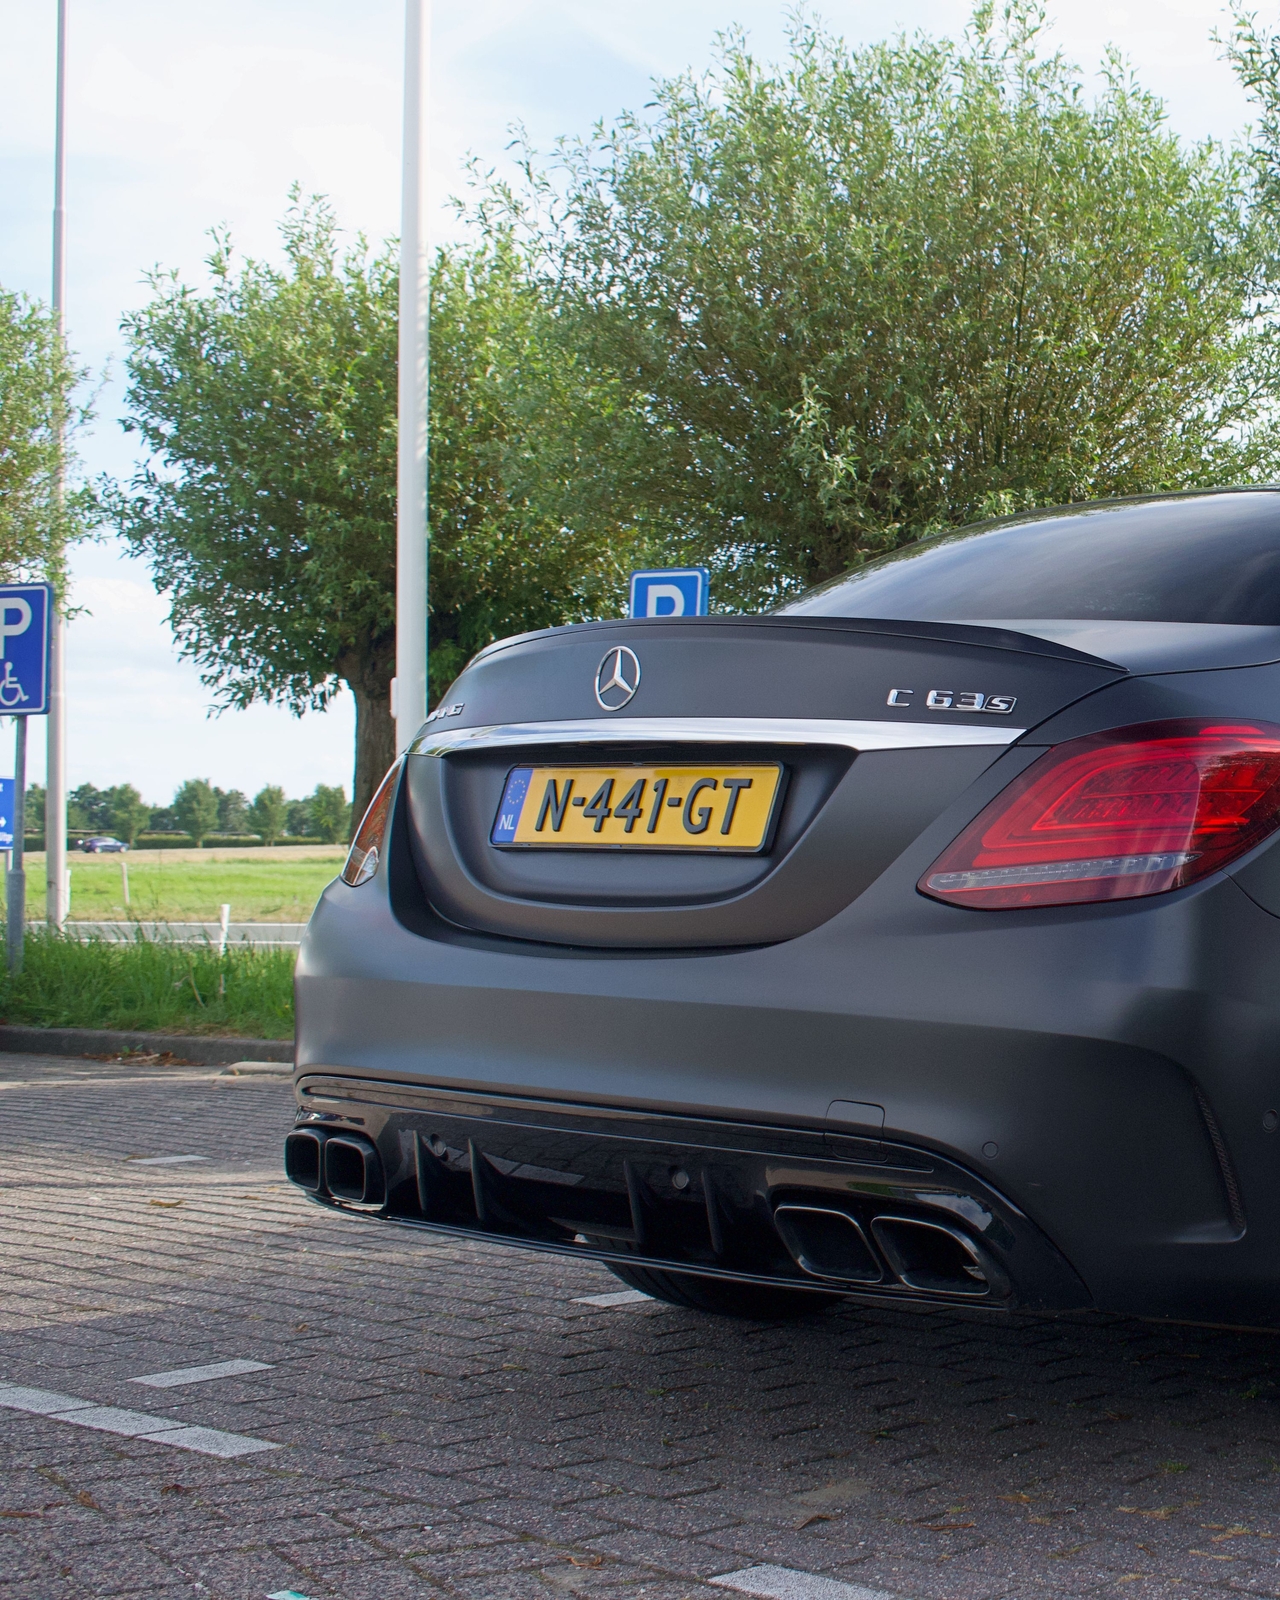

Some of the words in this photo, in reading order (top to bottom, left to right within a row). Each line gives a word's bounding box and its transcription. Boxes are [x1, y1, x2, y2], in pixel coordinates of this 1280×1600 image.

[0, 597, 33, 660] P
[886, 689, 914, 707] C
[499, 814, 515, 831] NL
[534, 778, 753, 835] N-441-GT
